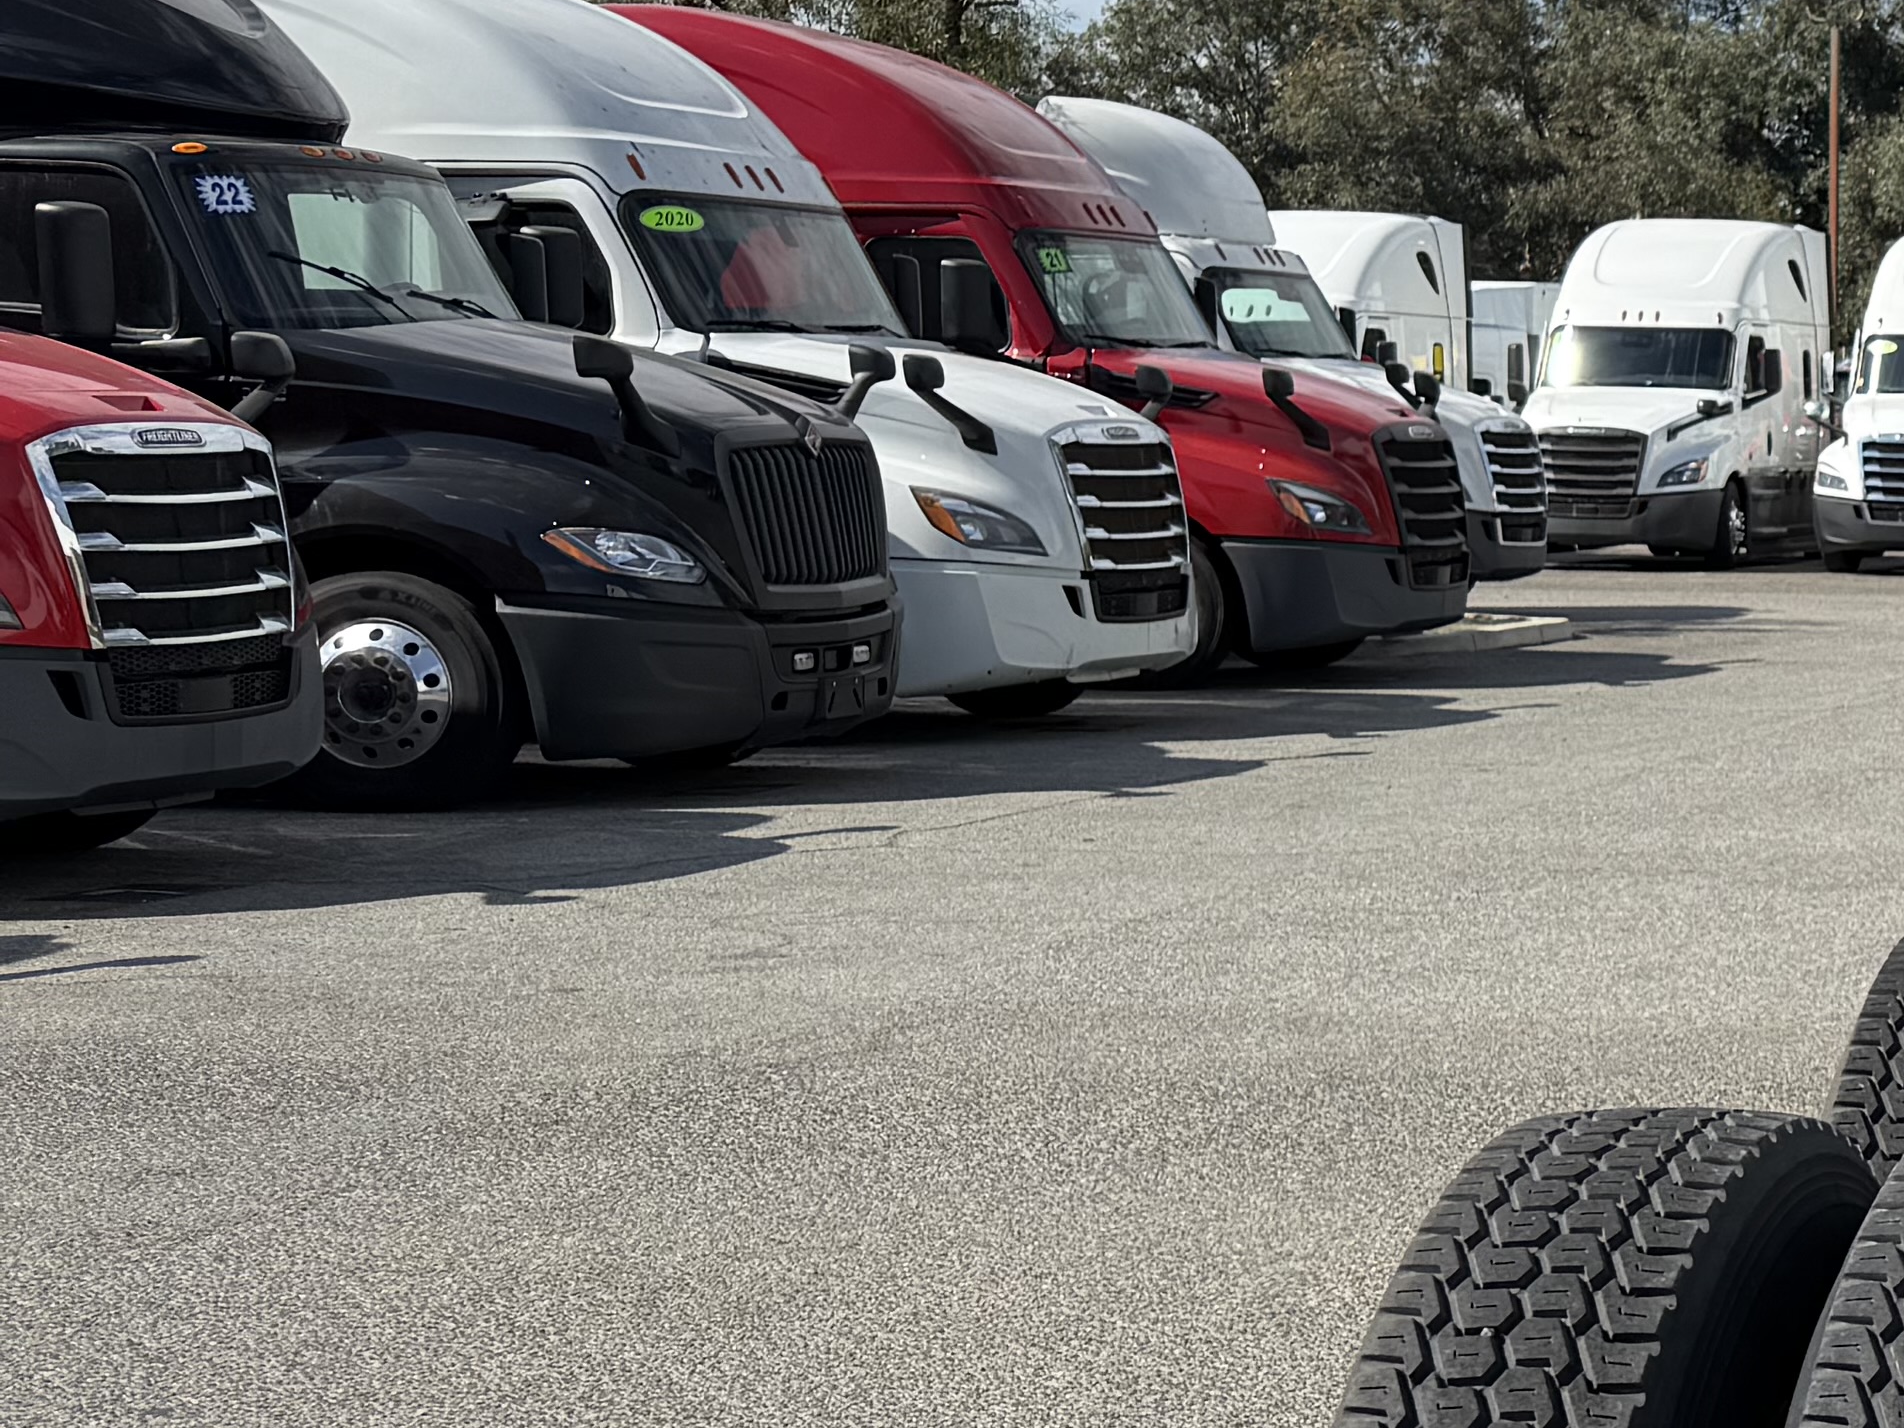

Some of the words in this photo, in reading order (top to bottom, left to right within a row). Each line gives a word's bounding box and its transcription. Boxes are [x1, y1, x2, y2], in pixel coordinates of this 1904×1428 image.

[211, 182, 245, 205] 22
[654, 211, 694, 227] 2020
[1045, 251, 1063, 268] 21
